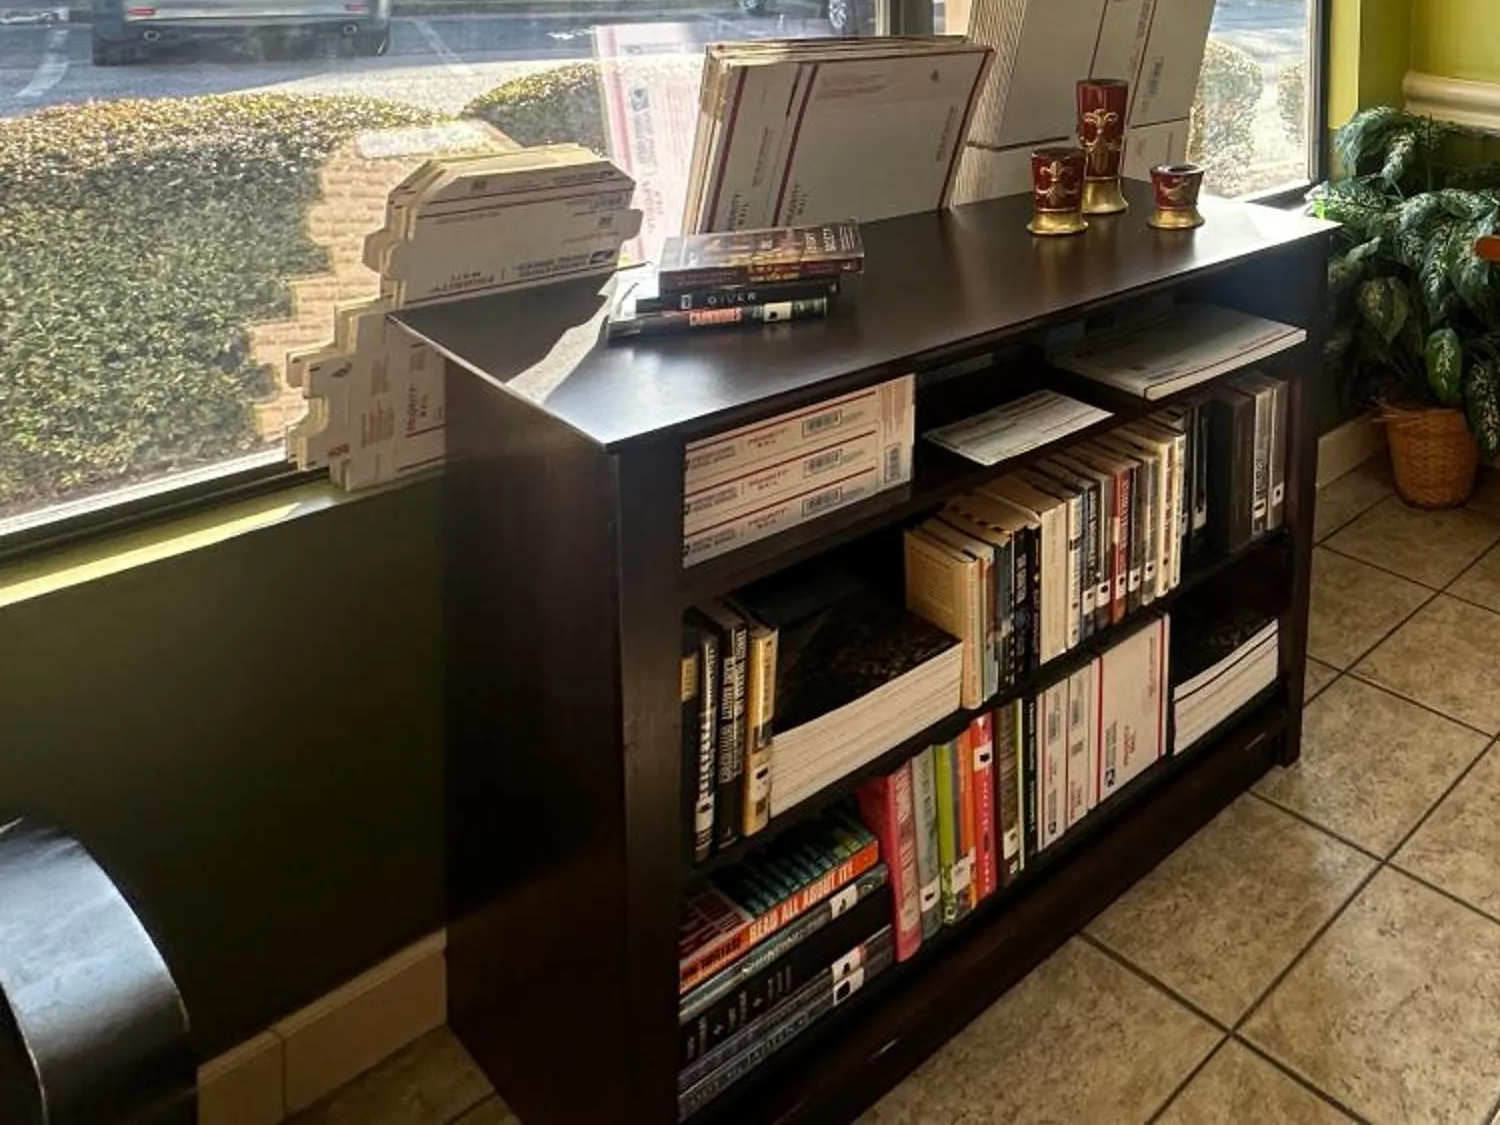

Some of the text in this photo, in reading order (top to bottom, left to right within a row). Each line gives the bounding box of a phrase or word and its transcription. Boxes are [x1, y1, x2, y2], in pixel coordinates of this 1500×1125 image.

[749, 910, 778, 944] READ
[781, 898, 800, 922] ALL
[802, 871, 837, 908] ABOUT
